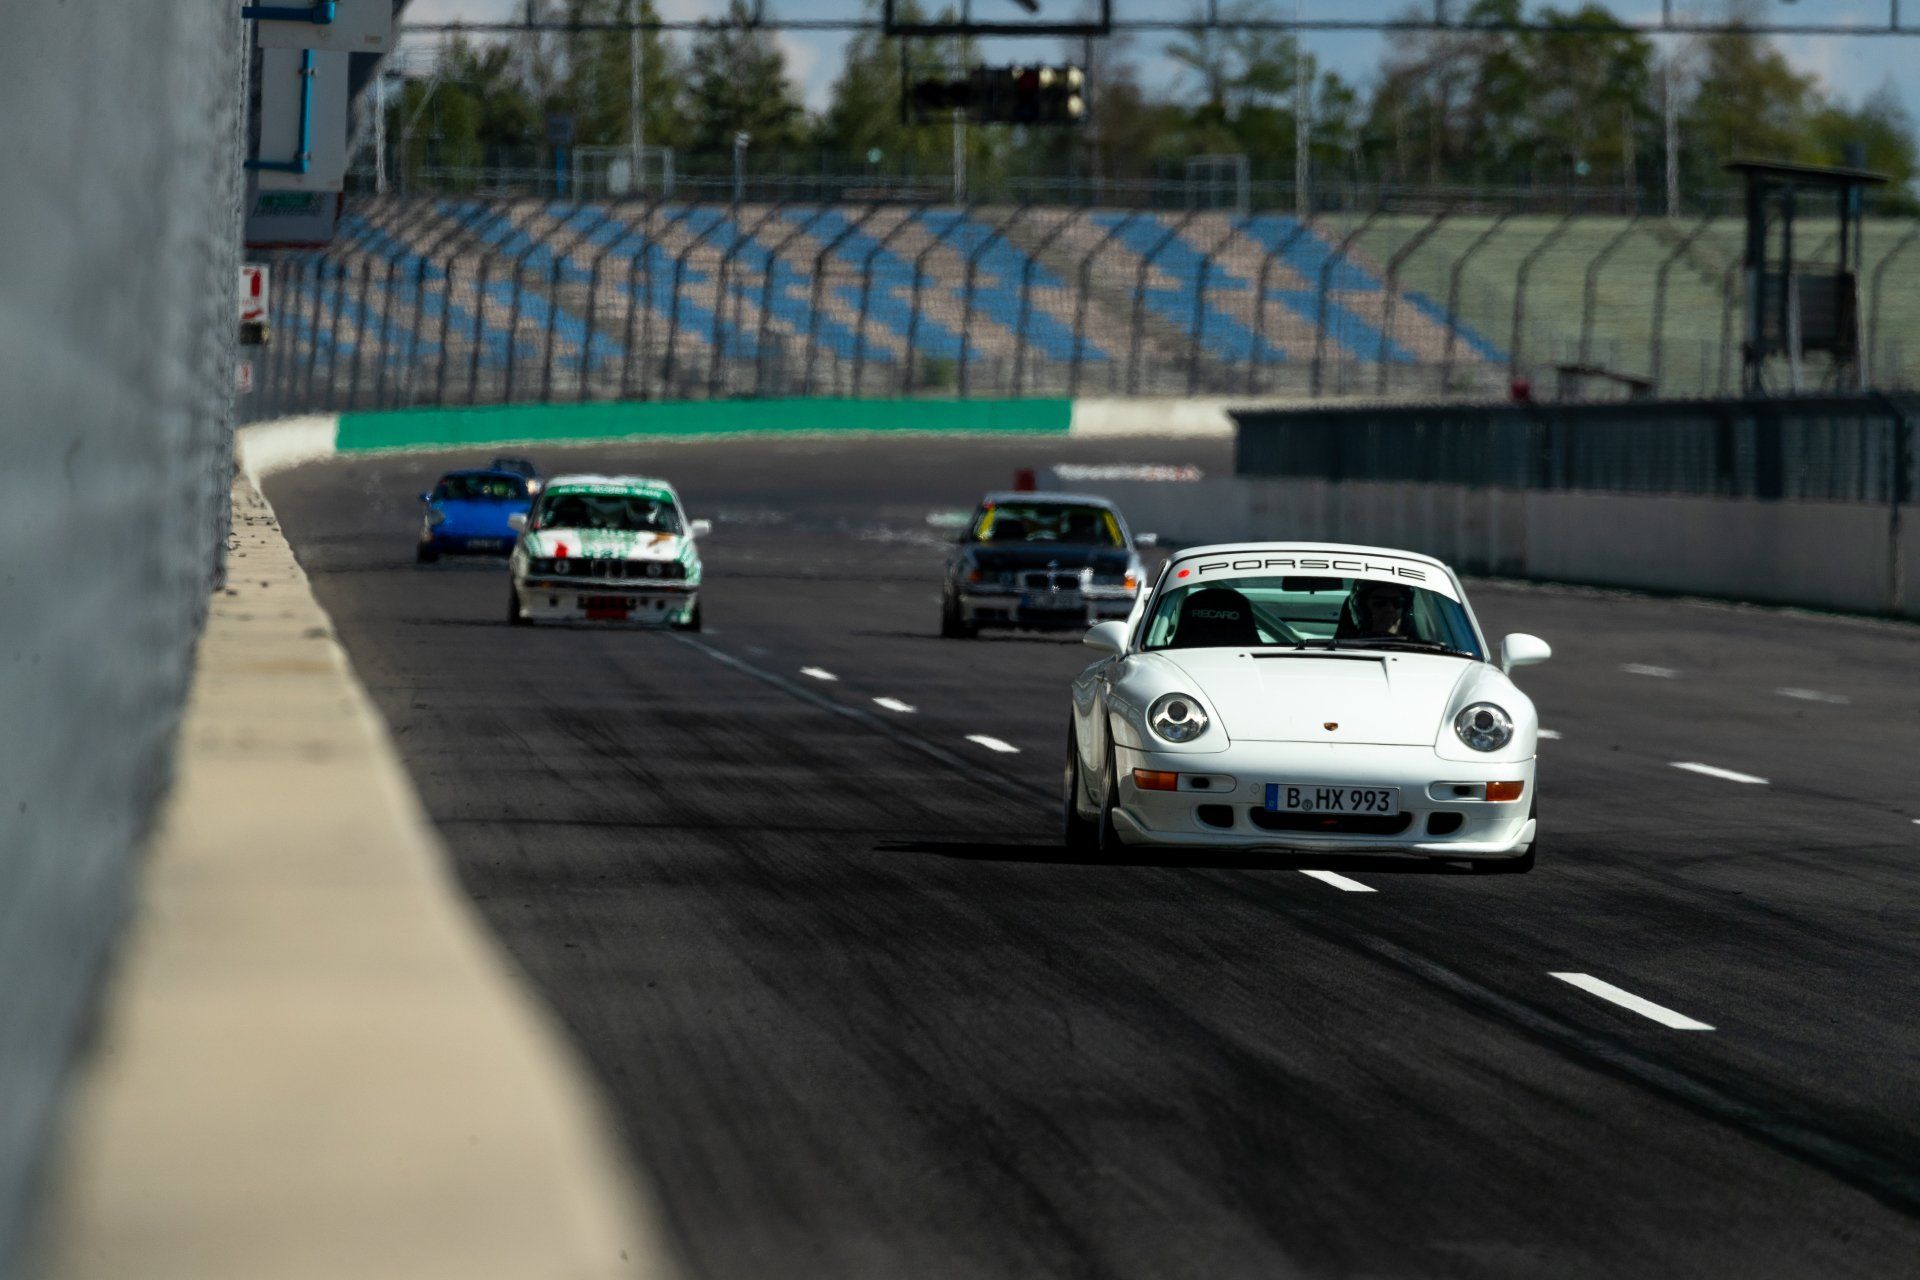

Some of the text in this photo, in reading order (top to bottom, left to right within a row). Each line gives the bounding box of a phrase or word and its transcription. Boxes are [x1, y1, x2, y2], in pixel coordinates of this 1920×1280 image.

[1198, 558, 1427, 582] PORSCHE
[1191, 608, 1240, 621] RECARO
[1286, 787, 1390, 812] B HX 993
